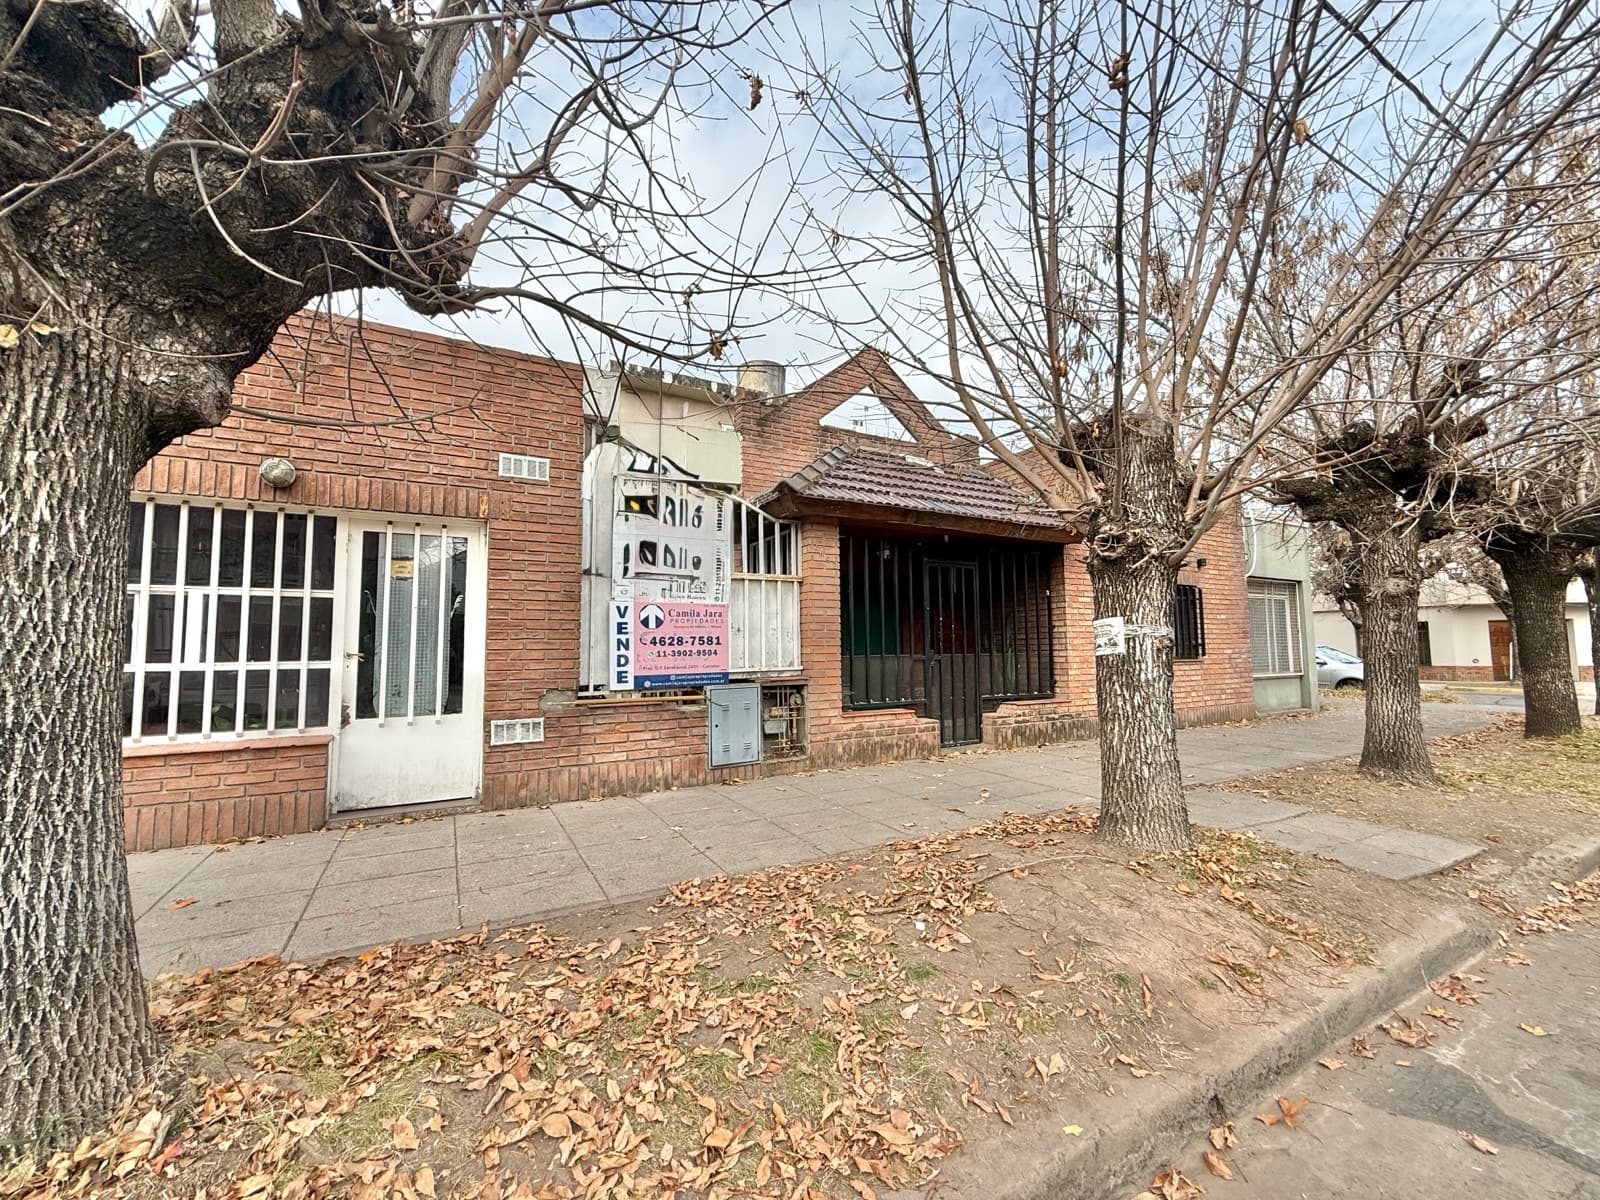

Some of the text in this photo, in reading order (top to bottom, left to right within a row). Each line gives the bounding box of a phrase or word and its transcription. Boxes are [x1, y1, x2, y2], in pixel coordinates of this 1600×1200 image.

[668, 608, 723, 618] Camila Jara
[616, 605, 630, 684] VENDE
[650, 636, 722, 647] 4628-7581
[656, 649, 718, 658] 11-3902-9504
